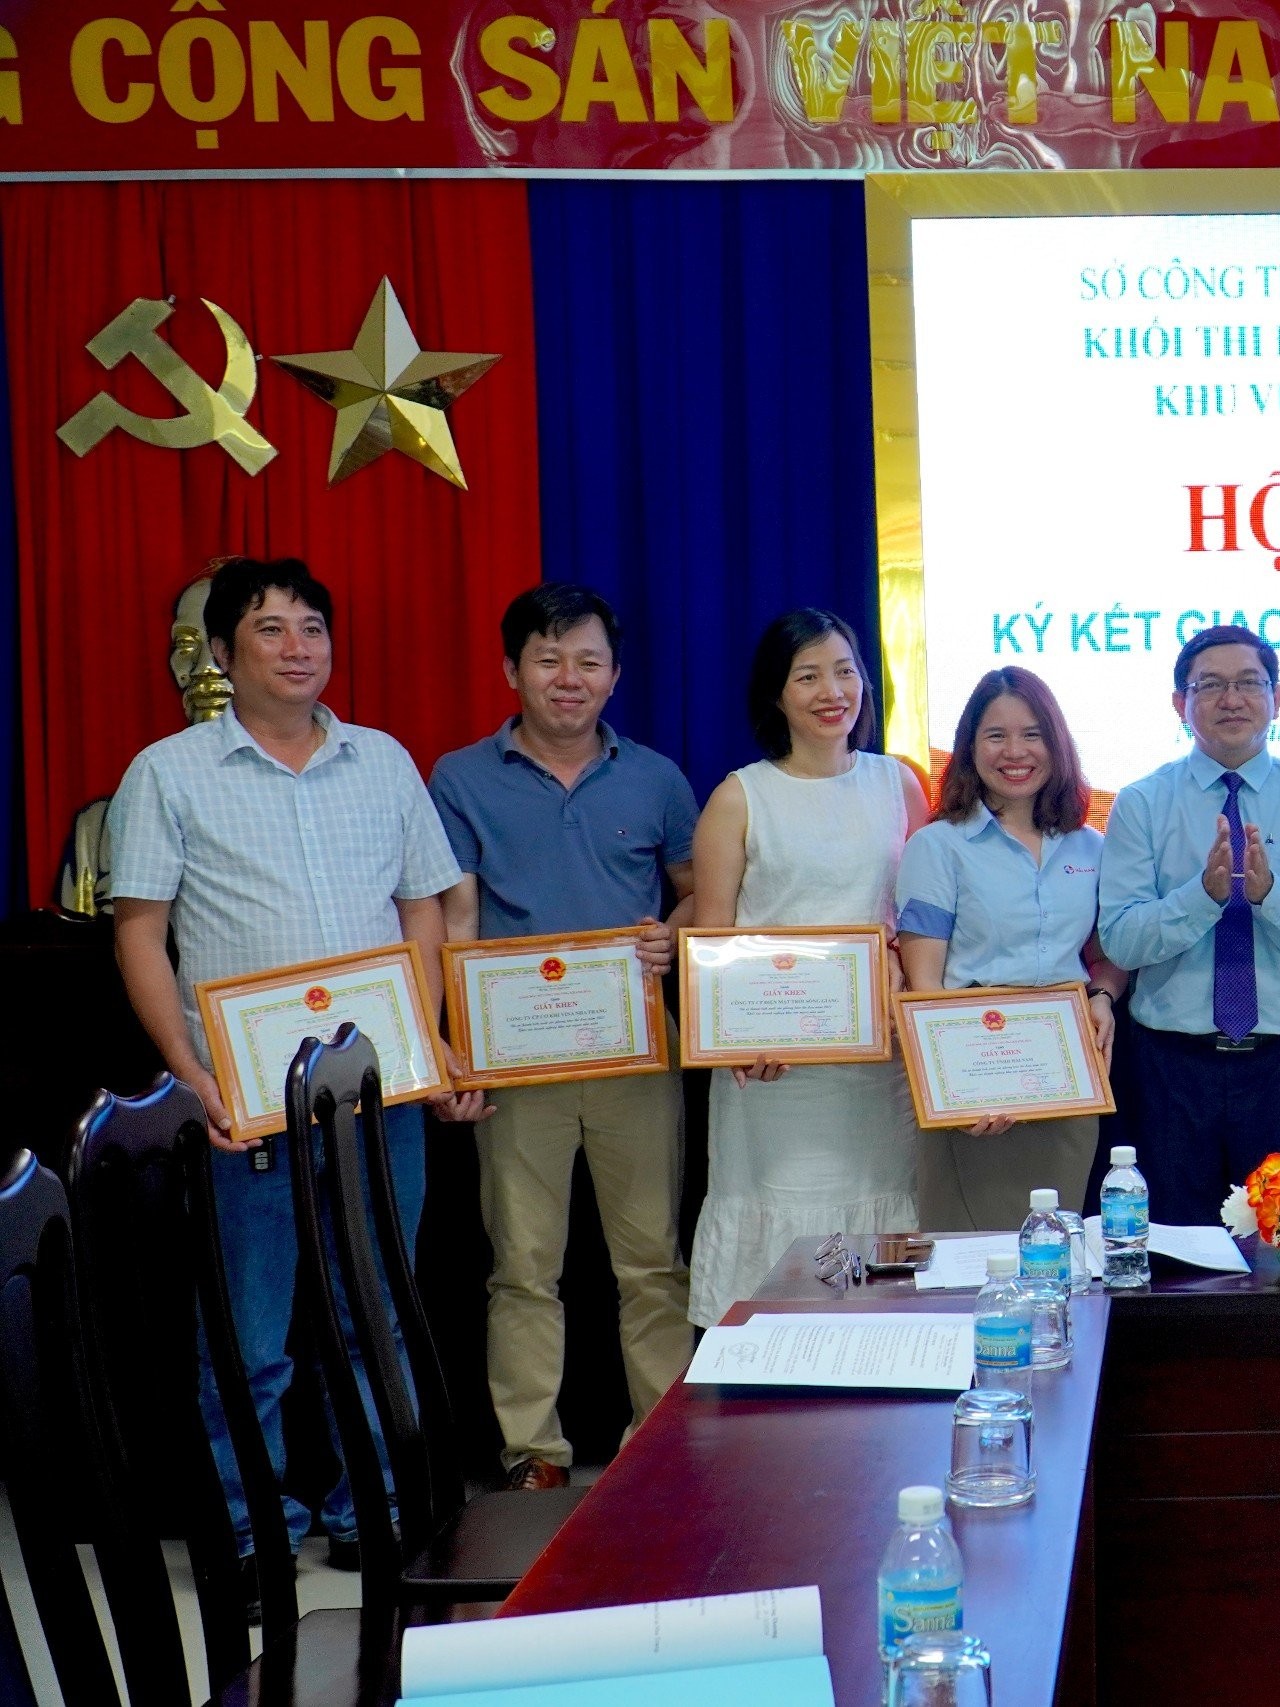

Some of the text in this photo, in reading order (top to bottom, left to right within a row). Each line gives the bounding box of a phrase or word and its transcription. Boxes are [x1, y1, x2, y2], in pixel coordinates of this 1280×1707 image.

[70, 0, 425, 149] CỘNG
[780, 0, 1062, 150] VIỆT
[1138, 256, 1244, 300] CÔNG
[1195, 325, 1262, 358] THI
[1155, 383, 1237, 416] KHU
[992, 601, 1054, 654] KÝ
[555, 1001, 578, 1009] KHEN
[1001, 1048, 1022, 1056] KHEN
[894, 1603, 956, 1633] Sanna
